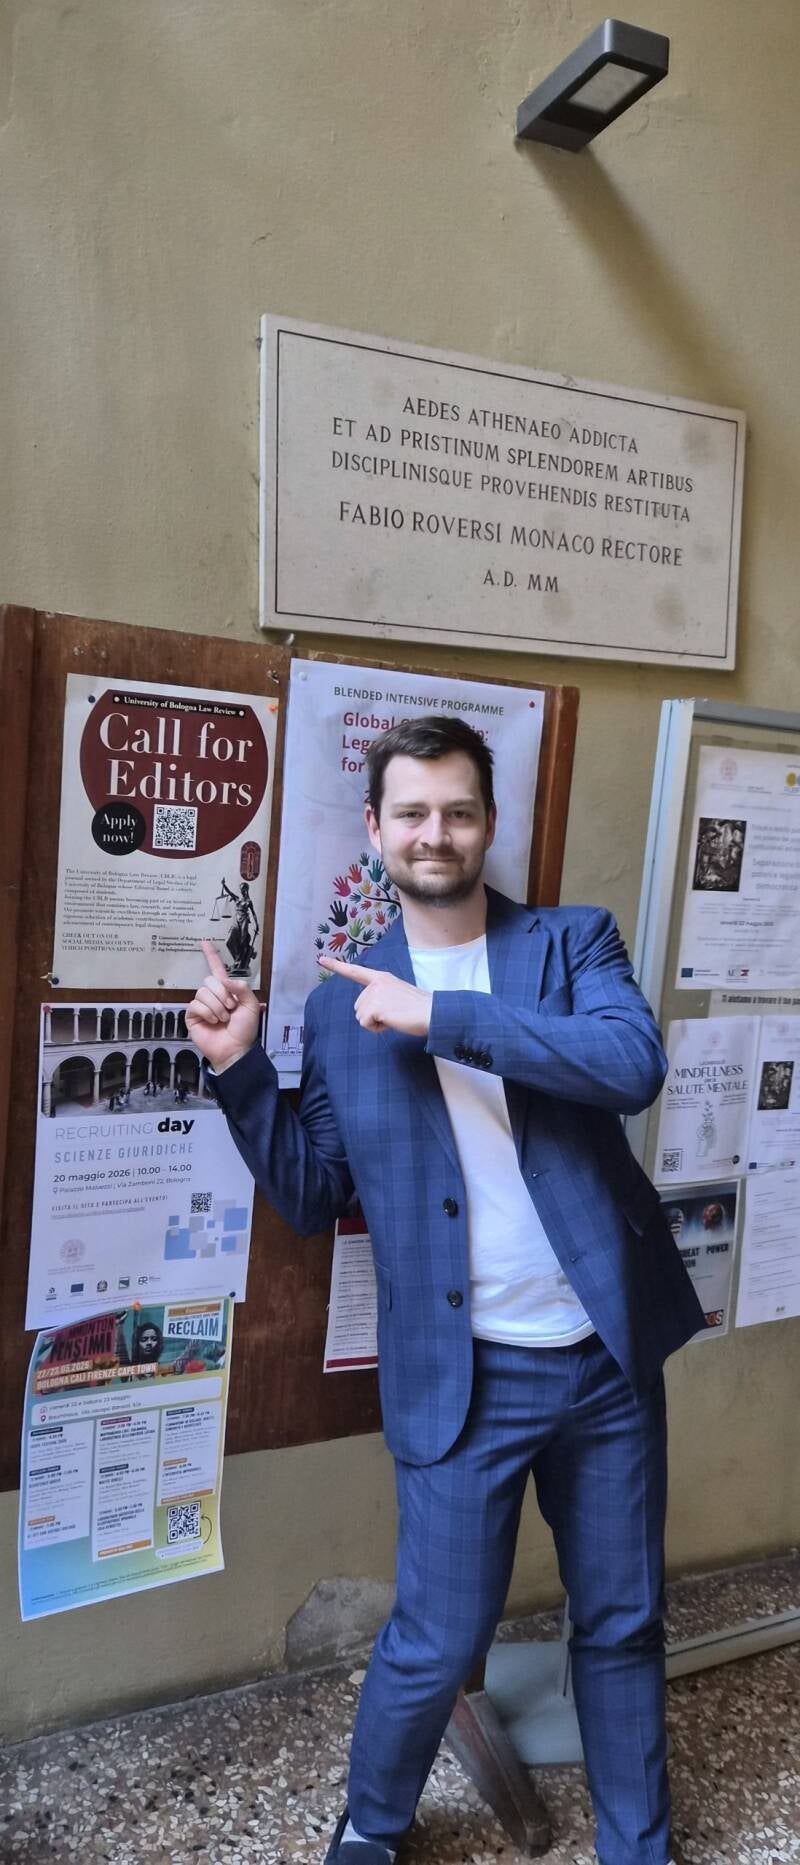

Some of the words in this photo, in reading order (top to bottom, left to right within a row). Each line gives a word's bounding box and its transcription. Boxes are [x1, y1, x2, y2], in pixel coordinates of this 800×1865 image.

[402, 396, 461, 422] AEDES
[467, 408, 562, 440] ATHENAEO
[569, 428, 638, 454] ADDICTA
[333, 417, 356, 437] ET
[365, 424, 392, 443] AD
[400, 429, 500, 463] PRISTINUM
[507, 448, 619, 482] SPLENDOREM
[626, 468, 694, 493] ARTIBUS
[331, 451, 473, 490] DISCIPLINISQUE
[480, 475, 597, 509] PROVEHENDIS
[604, 494, 690, 522] RESTITUTA
[339, 500, 405, 529] FABIO
[412, 511, 502, 544] ROVERSI
[510, 525, 595, 556] MONACO
[601, 538, 683, 567] RECTORE
[483, 570, 517, 588] A.D.
[528, 574, 559, 593] MM
[124, 696, 158, 708] University
[160, 700, 168, 708] of
[169, 702, 197, 712] Bologna
[198, 704, 212, 713] Law
[214, 706, 236, 716] Review
[334, 686, 383, 701] BLENDED
[386, 692, 439, 708] INTENSIVE
[441, 699, 504, 716] PROGRAMME
[99, 712, 182, 756] Call
[196, 721, 254, 763] for
[342, 735, 374, 755] Leg
[341, 756, 366, 773] for
[106, 758, 253, 807] Editors
[100, 813, 137, 831] Apply
[103, 828, 134, 844] now!
[674, 1064, 744, 1079] MINDFULNESS
[667, 1084, 704, 1096] SALUTE
[706, 1080, 748, 1093] MENTALE
[55, 1122, 153, 1140] RECRUITING
[157, 1117, 195, 1134] day
[54, 1148, 112, 1163] SCIENZE
[118, 1142, 193, 1159] GIURIDICHE
[53, 1174, 66, 1182] 20
[68, 1171, 106, 1182] maggio
[108, 1169, 130, 1178] 2026
[138, 1166, 160, 1175] 10.00
[168, 1163, 192, 1173] 14.00
[168, 1317, 219, 1337] RECLAIM
[36, 1377, 70, 1390] BOLOGNA
[70, 1374, 86, 1384] CALI
[87, 1369, 117, 1382] FIRENZE
[117, 1366, 137, 1377] CAPE
[137, 1362, 157, 1375] TOWN
